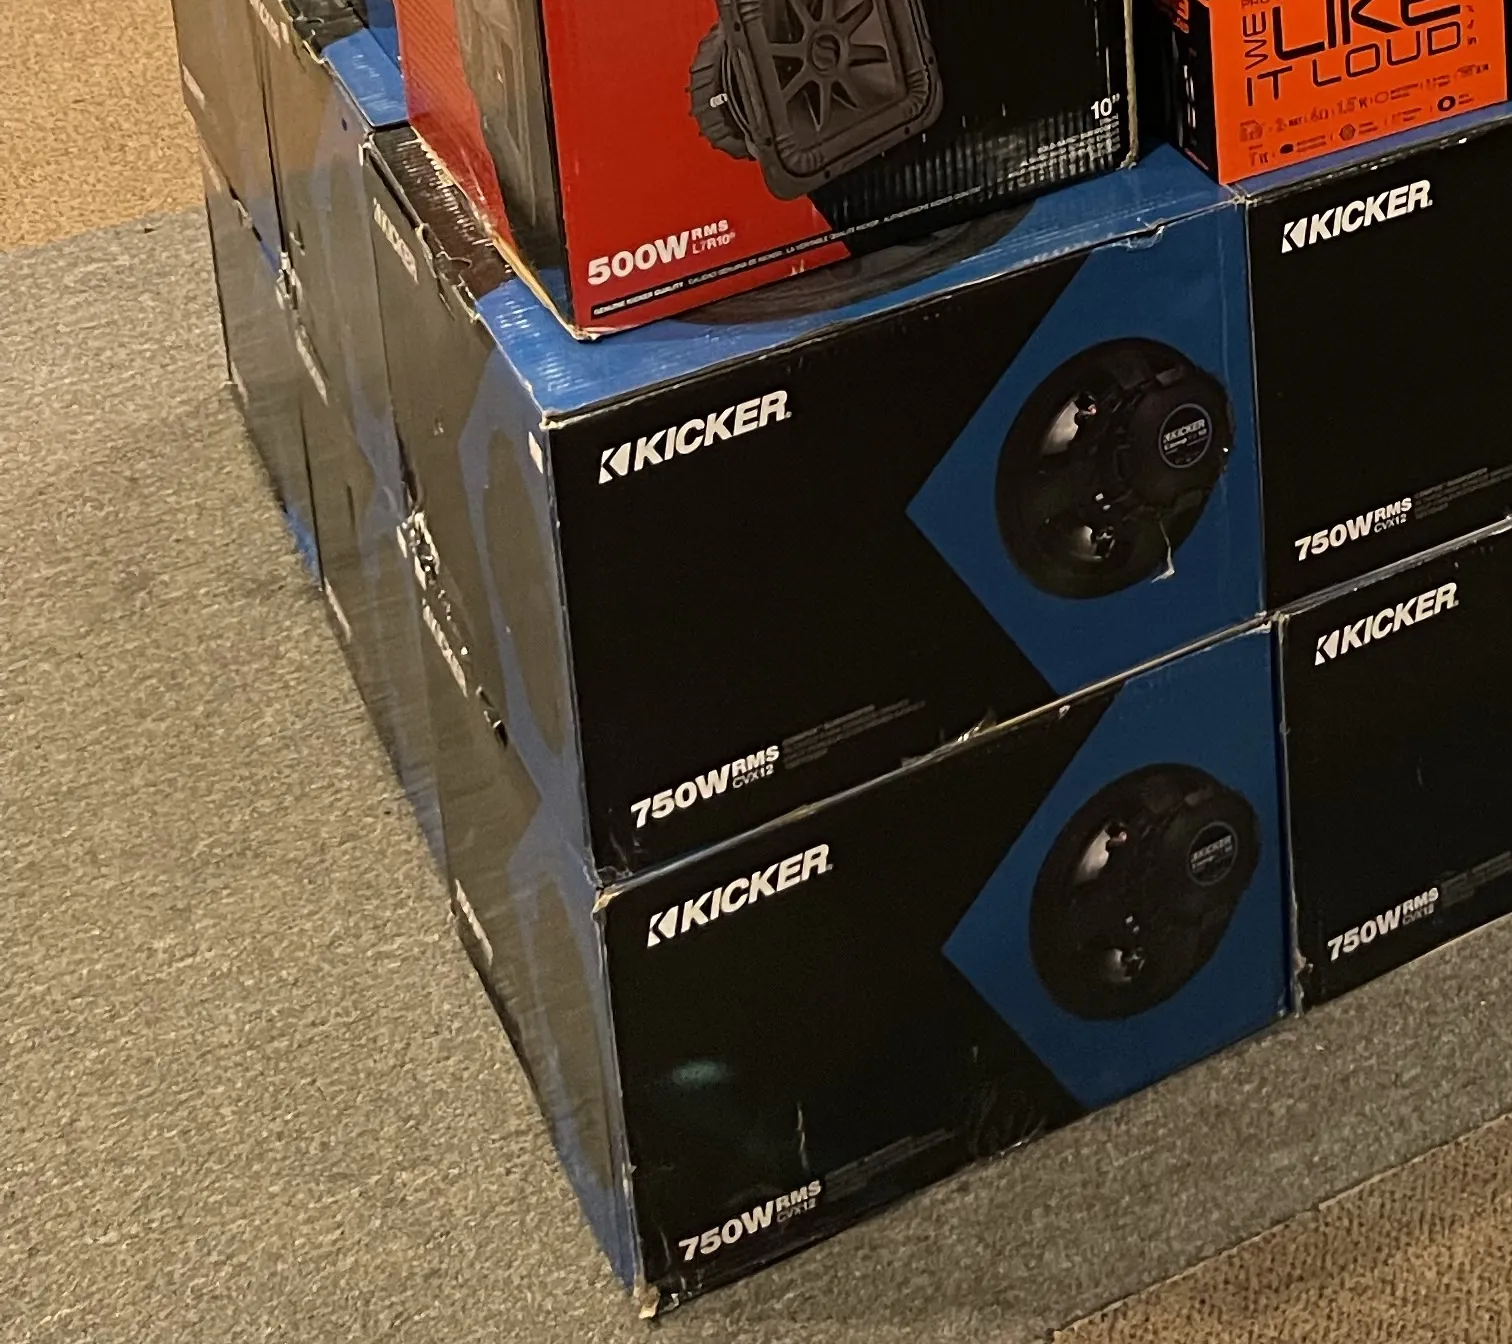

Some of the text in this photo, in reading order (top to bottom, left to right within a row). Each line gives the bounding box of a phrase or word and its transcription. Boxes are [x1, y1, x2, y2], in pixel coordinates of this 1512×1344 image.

[1242, 10, 1269, 70] WE
[1246, 20, 1461, 107] IT LOUD
[1090, 94, 1121, 119] 10"
[1307, 179, 1430, 246] KICKER
[587, 219, 729, 286] 500W RMS
[634, 389, 789, 473] KICKER
[1295, 496, 1413, 562] 750W RMS
[1340, 582, 1457, 655] KICKER
[630, 744, 780, 829] 750W RMS
[680, 843, 829, 933] KICKER
[1327, 887, 1440, 962] 750W RMS
[678, 1178, 823, 1262] 750W RMS
